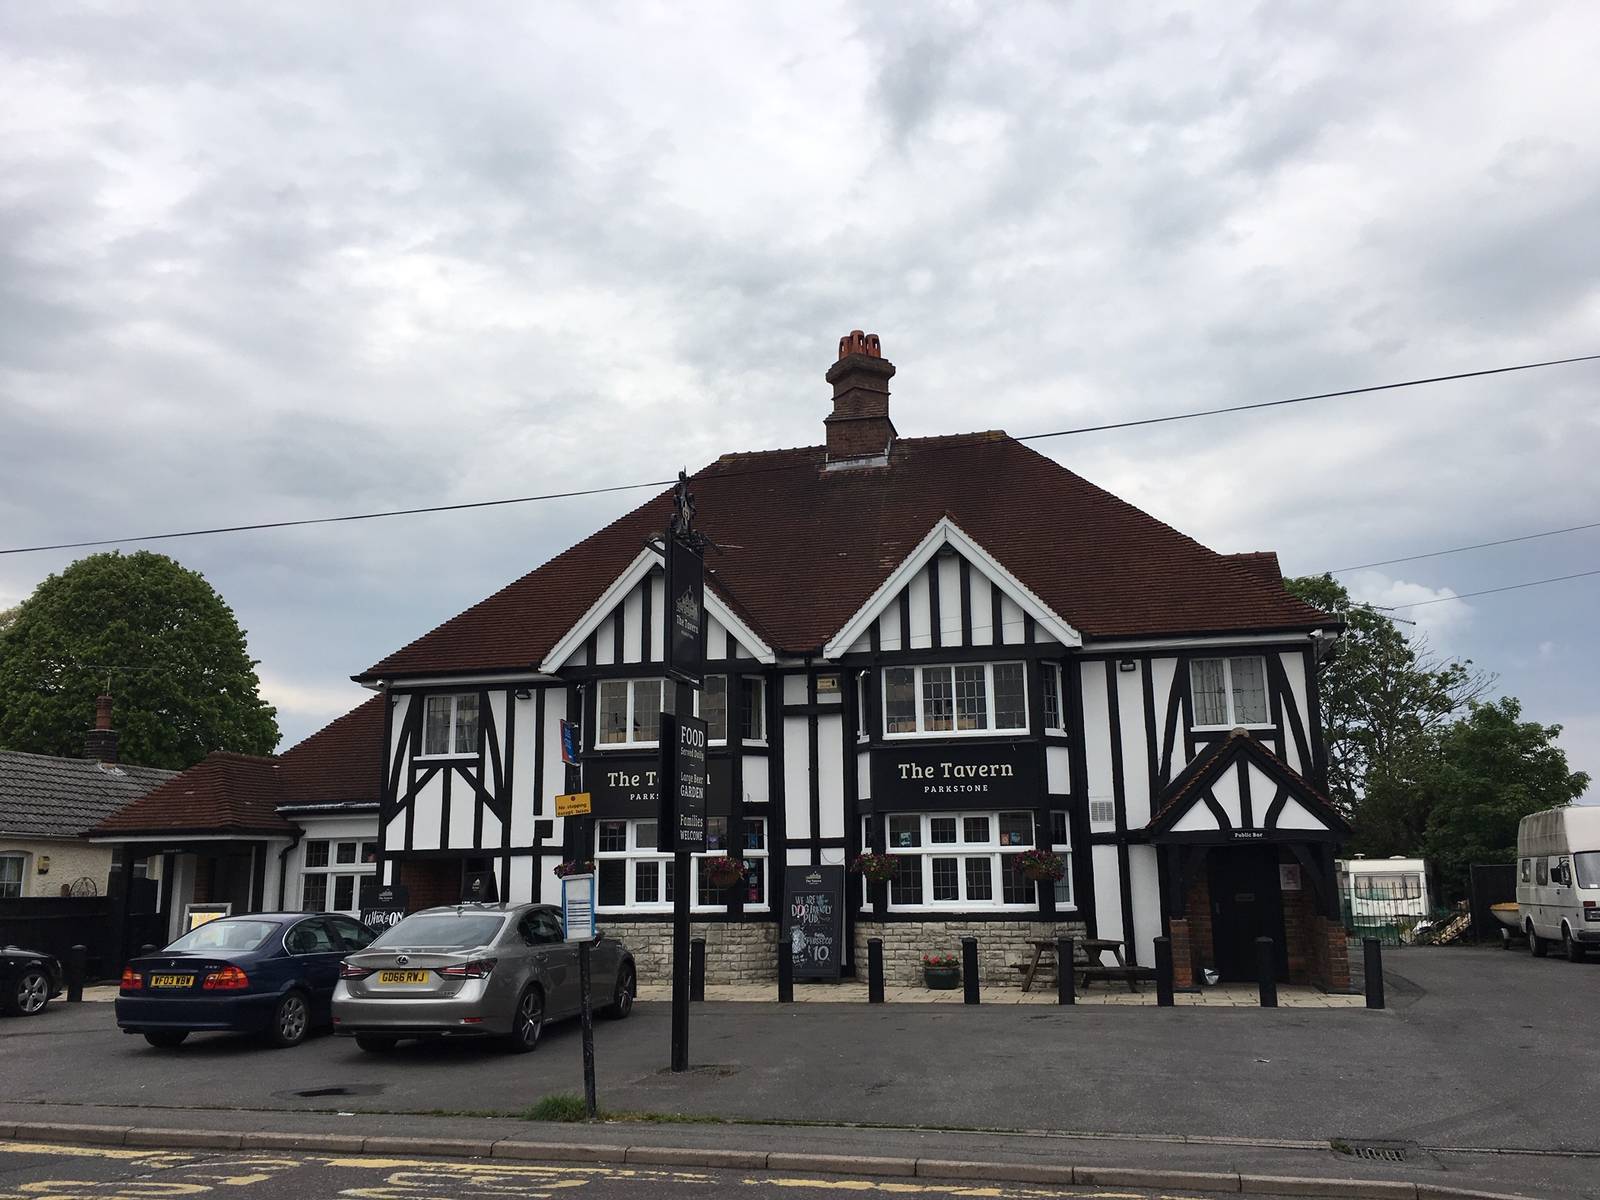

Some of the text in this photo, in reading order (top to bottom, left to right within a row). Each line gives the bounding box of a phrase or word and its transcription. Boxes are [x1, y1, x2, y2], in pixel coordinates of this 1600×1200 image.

[680, 725, 704, 748] FOOD
[898, 762, 1014, 779] The Tavern
[607, 771, 640, 787] The
[680, 784, 704, 799] GARDEN
[924, 784, 989, 793] PARKSTONE
[680, 814, 704, 827] Families
[680, 829, 703, 841] WELCOME
[381, 972, 425, 982] GD66 RWJ
